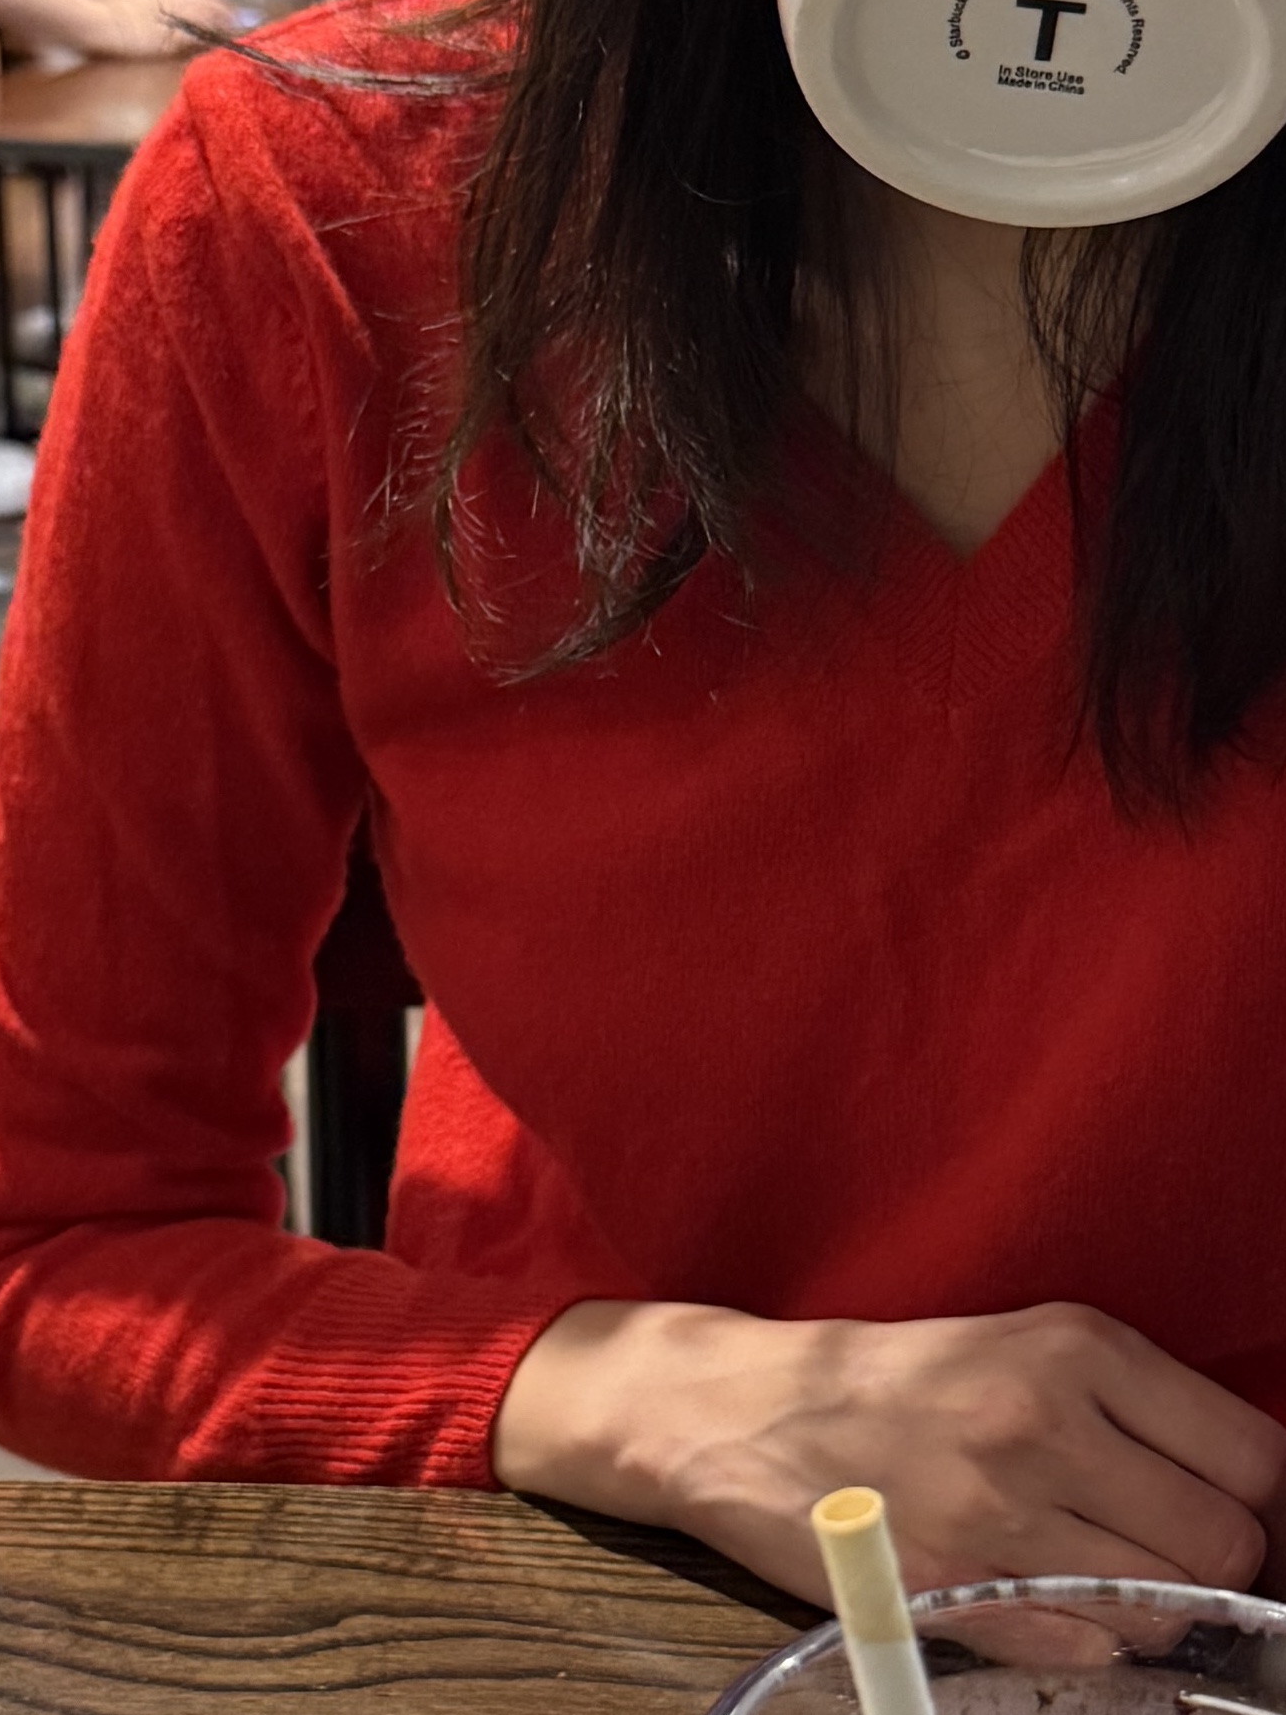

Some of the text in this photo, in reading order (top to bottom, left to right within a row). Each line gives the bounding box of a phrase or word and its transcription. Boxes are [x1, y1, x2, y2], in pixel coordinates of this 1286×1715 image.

[1113, 18, 1146, 76] Reserved
[998, 64, 1085, 85] In Store Use
[997, 76, 1033, 88] Made
[1048, 81, 1086, 95] China
